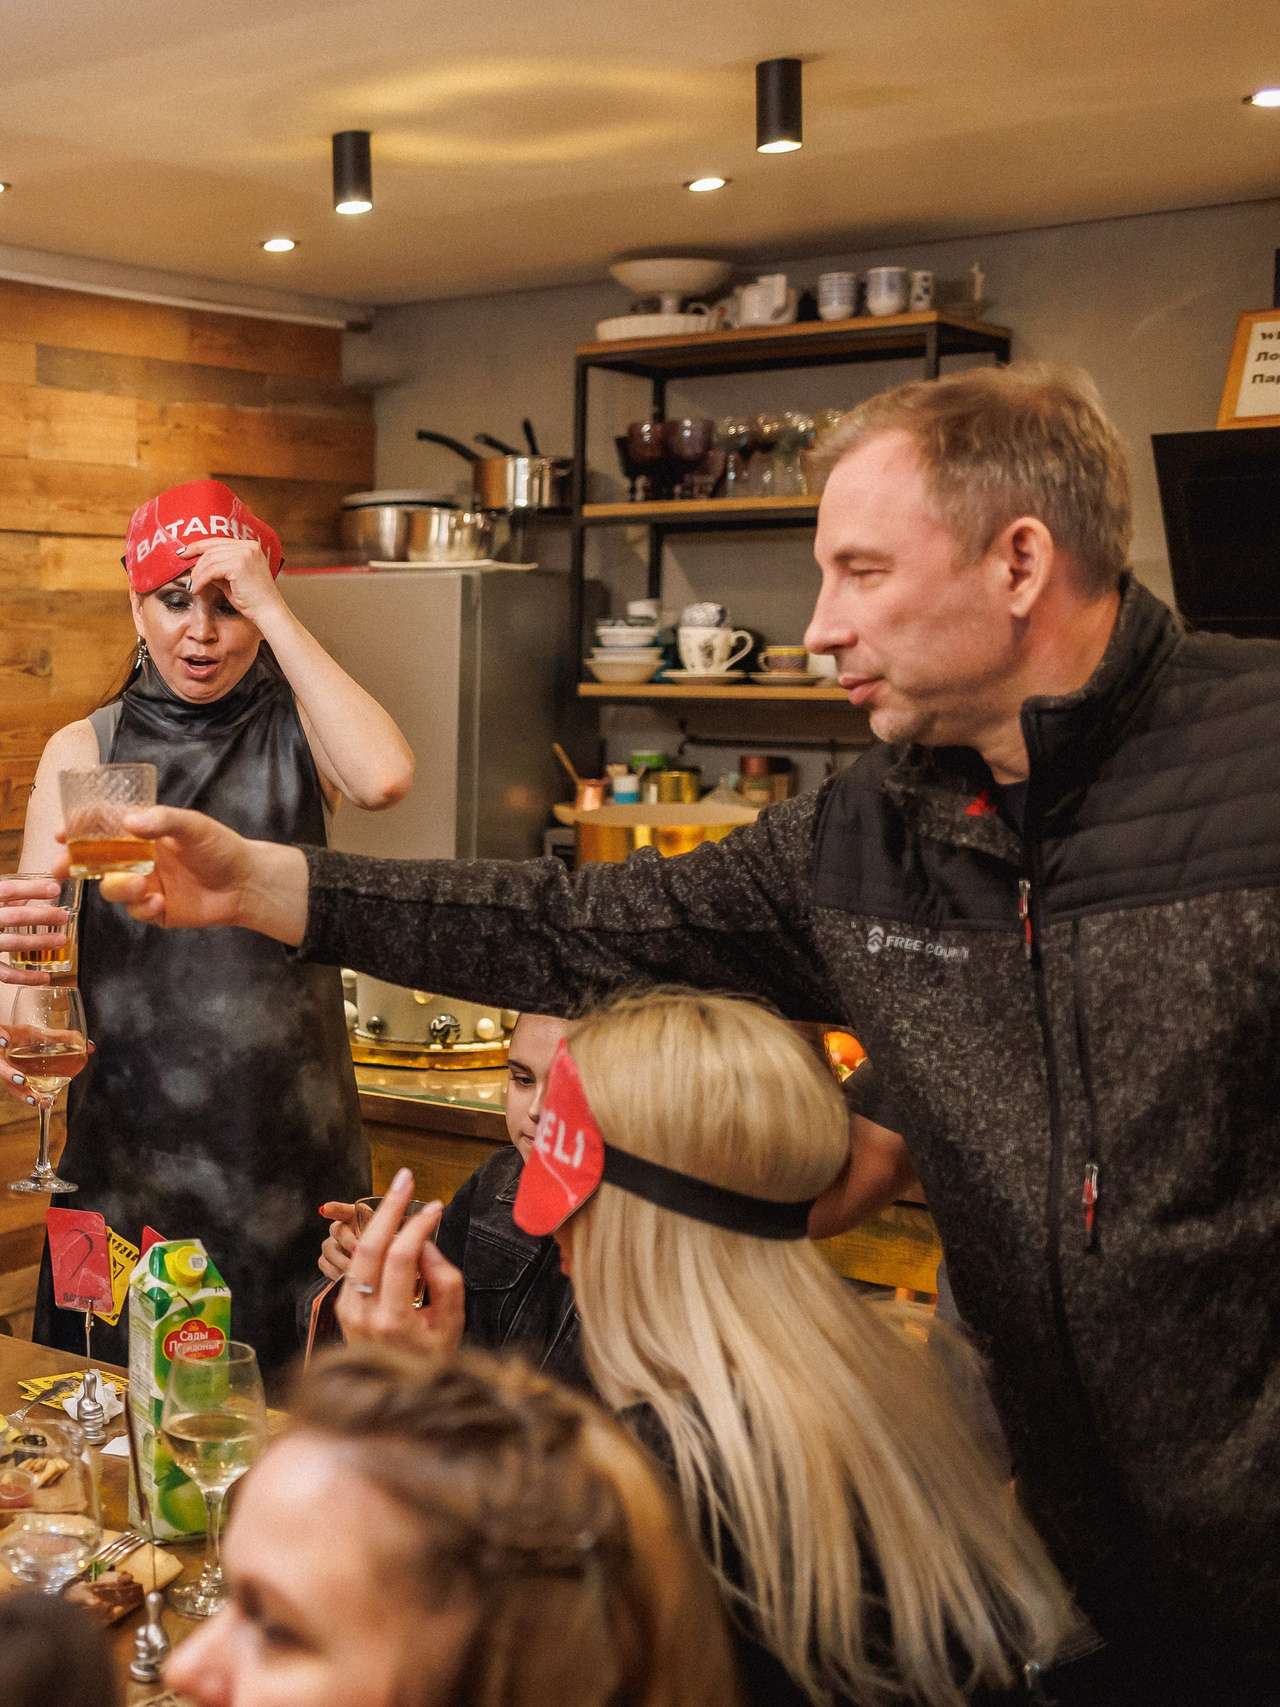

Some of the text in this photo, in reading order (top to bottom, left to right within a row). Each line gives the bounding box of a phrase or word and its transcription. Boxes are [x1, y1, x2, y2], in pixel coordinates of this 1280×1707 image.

[1255, 351, 1280, 361] Ло
[885, 935, 923, 951] FREE
[180, 1331, 209, 1342] Сады
